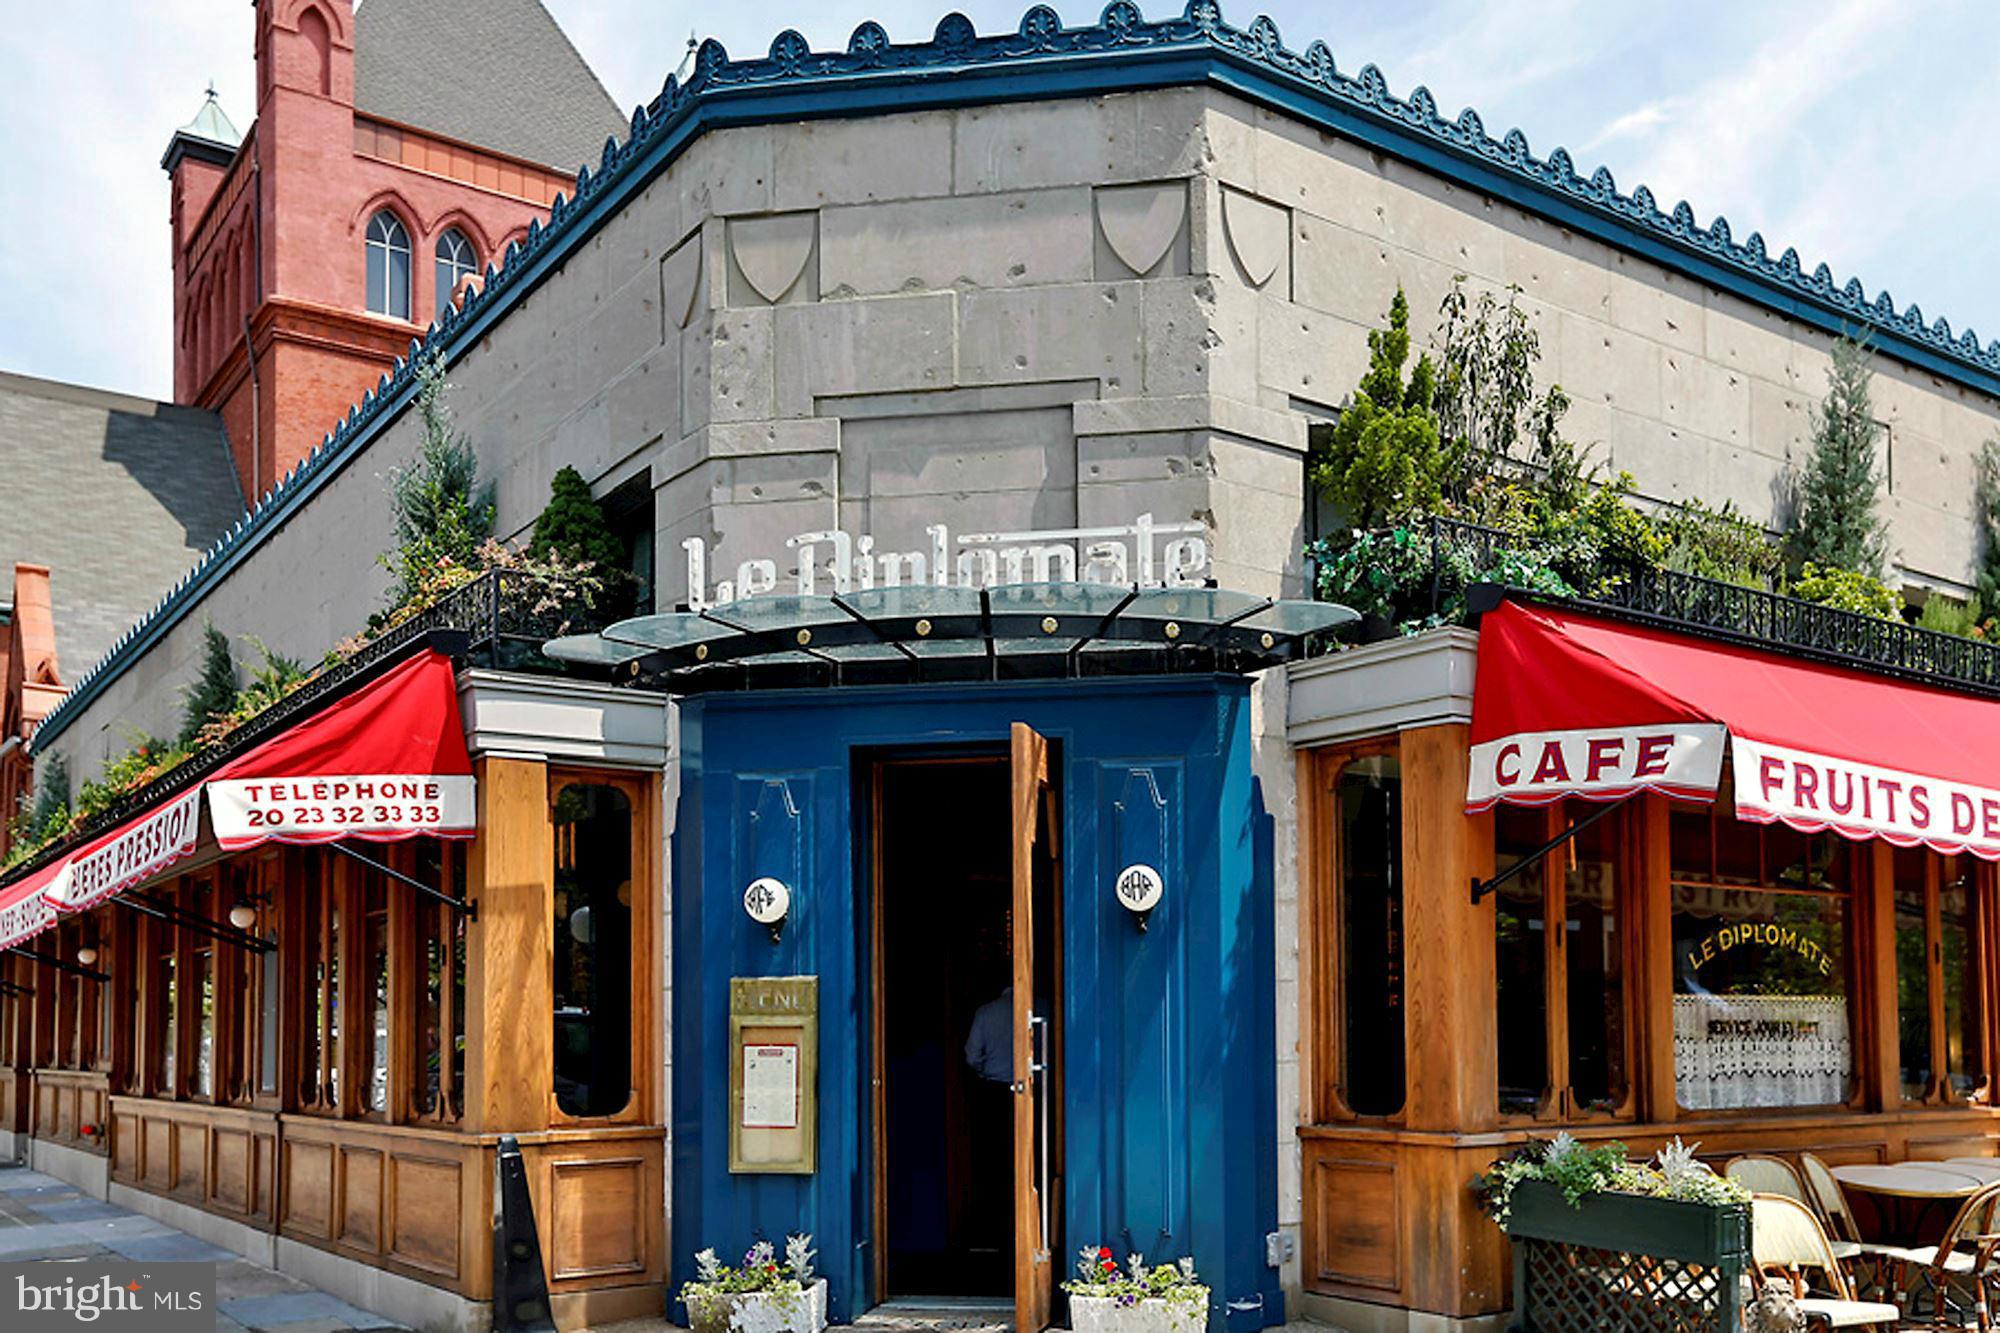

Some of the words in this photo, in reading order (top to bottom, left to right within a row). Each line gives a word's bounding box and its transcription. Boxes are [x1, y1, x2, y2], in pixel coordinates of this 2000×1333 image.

[682, 537, 776, 612] Le
[1495, 734, 1675, 787] CAFE
[247, 809, 284, 827] 20
[293, 806, 325, 824] 23
[332, 806, 364, 824] 32
[374, 805, 402, 823] 33
[410, 805, 441, 823] 33
[1759, 755, 1930, 829] FRUITS
[1951, 791, 2000, 839] DE
[1121, 870, 1153, 901] BAR
[1688, 937, 1716, 970] LE
[1718, 923, 1833, 976] DIPLOMATE
